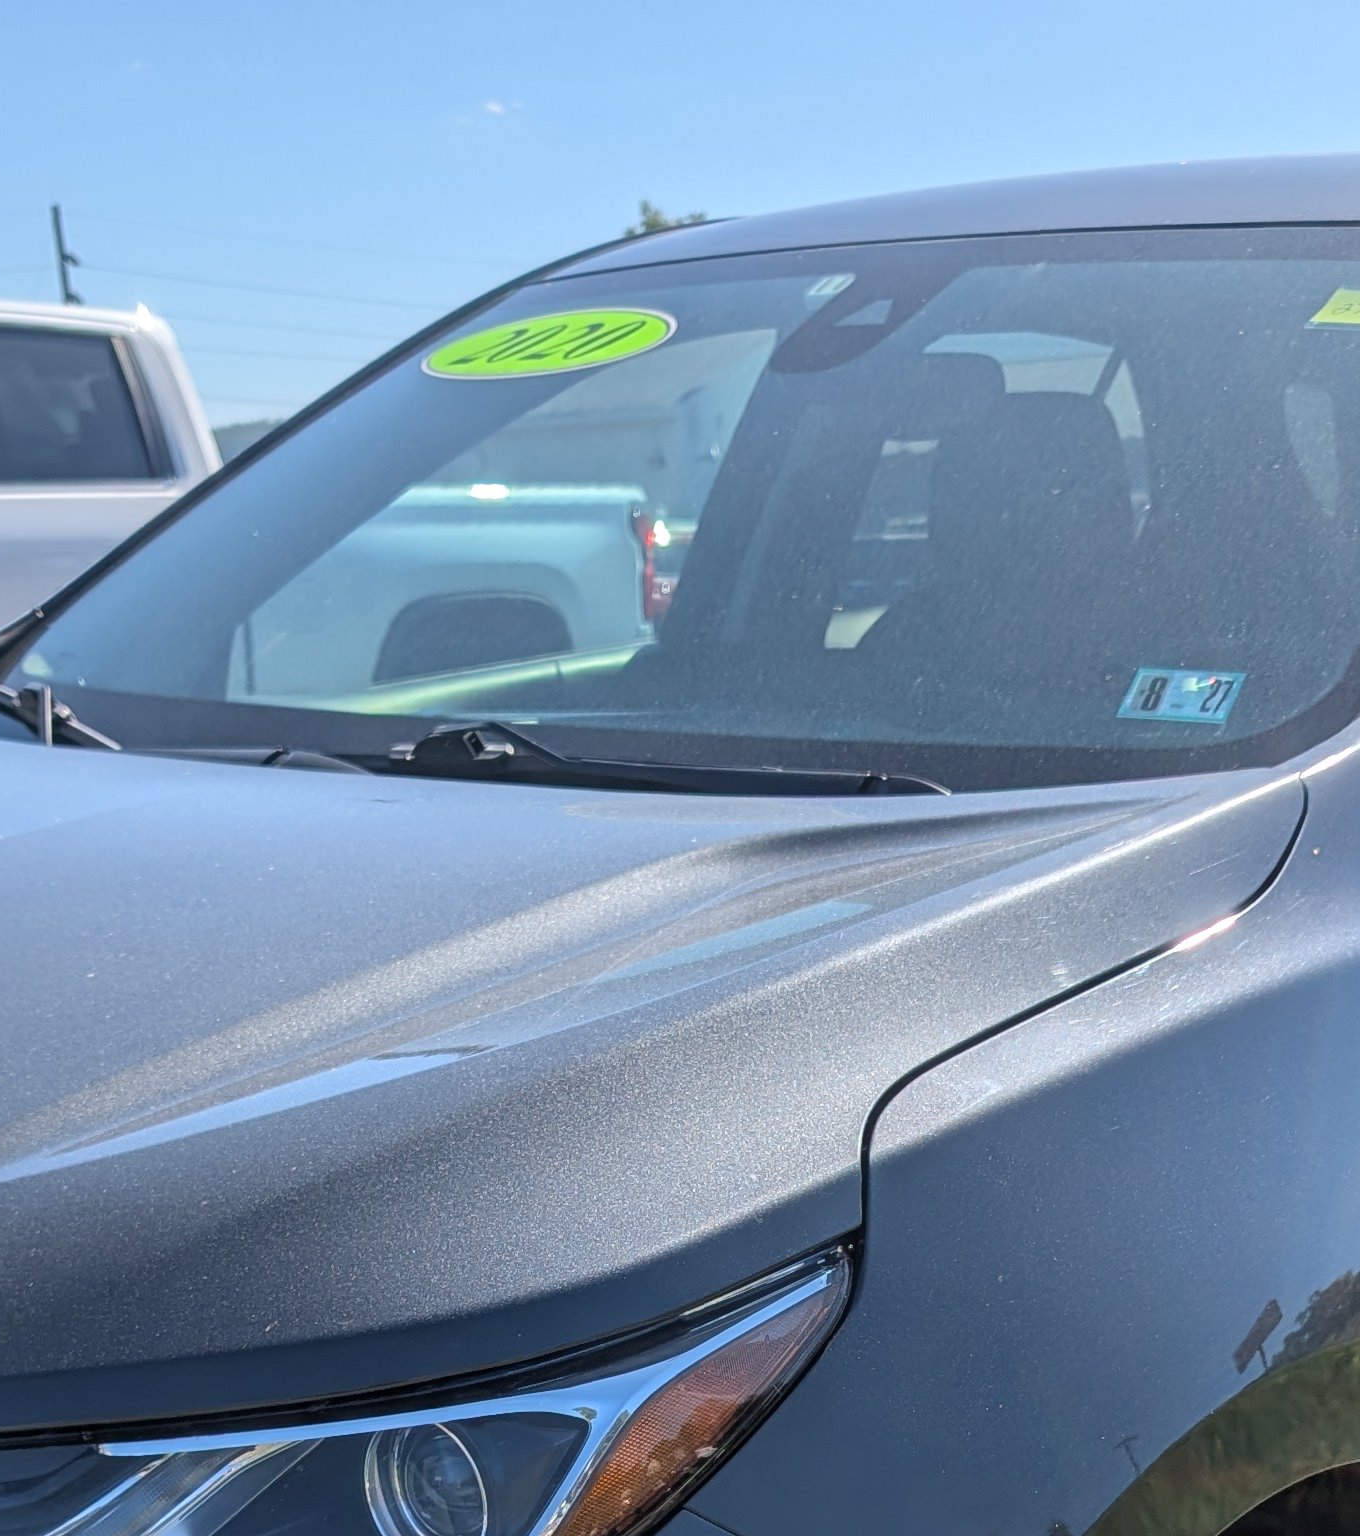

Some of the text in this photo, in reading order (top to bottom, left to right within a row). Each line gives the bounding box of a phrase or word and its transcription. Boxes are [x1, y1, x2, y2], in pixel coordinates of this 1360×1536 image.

[447, 319, 646, 366] 2020
[1141, 677, 1235, 714] 8 27
